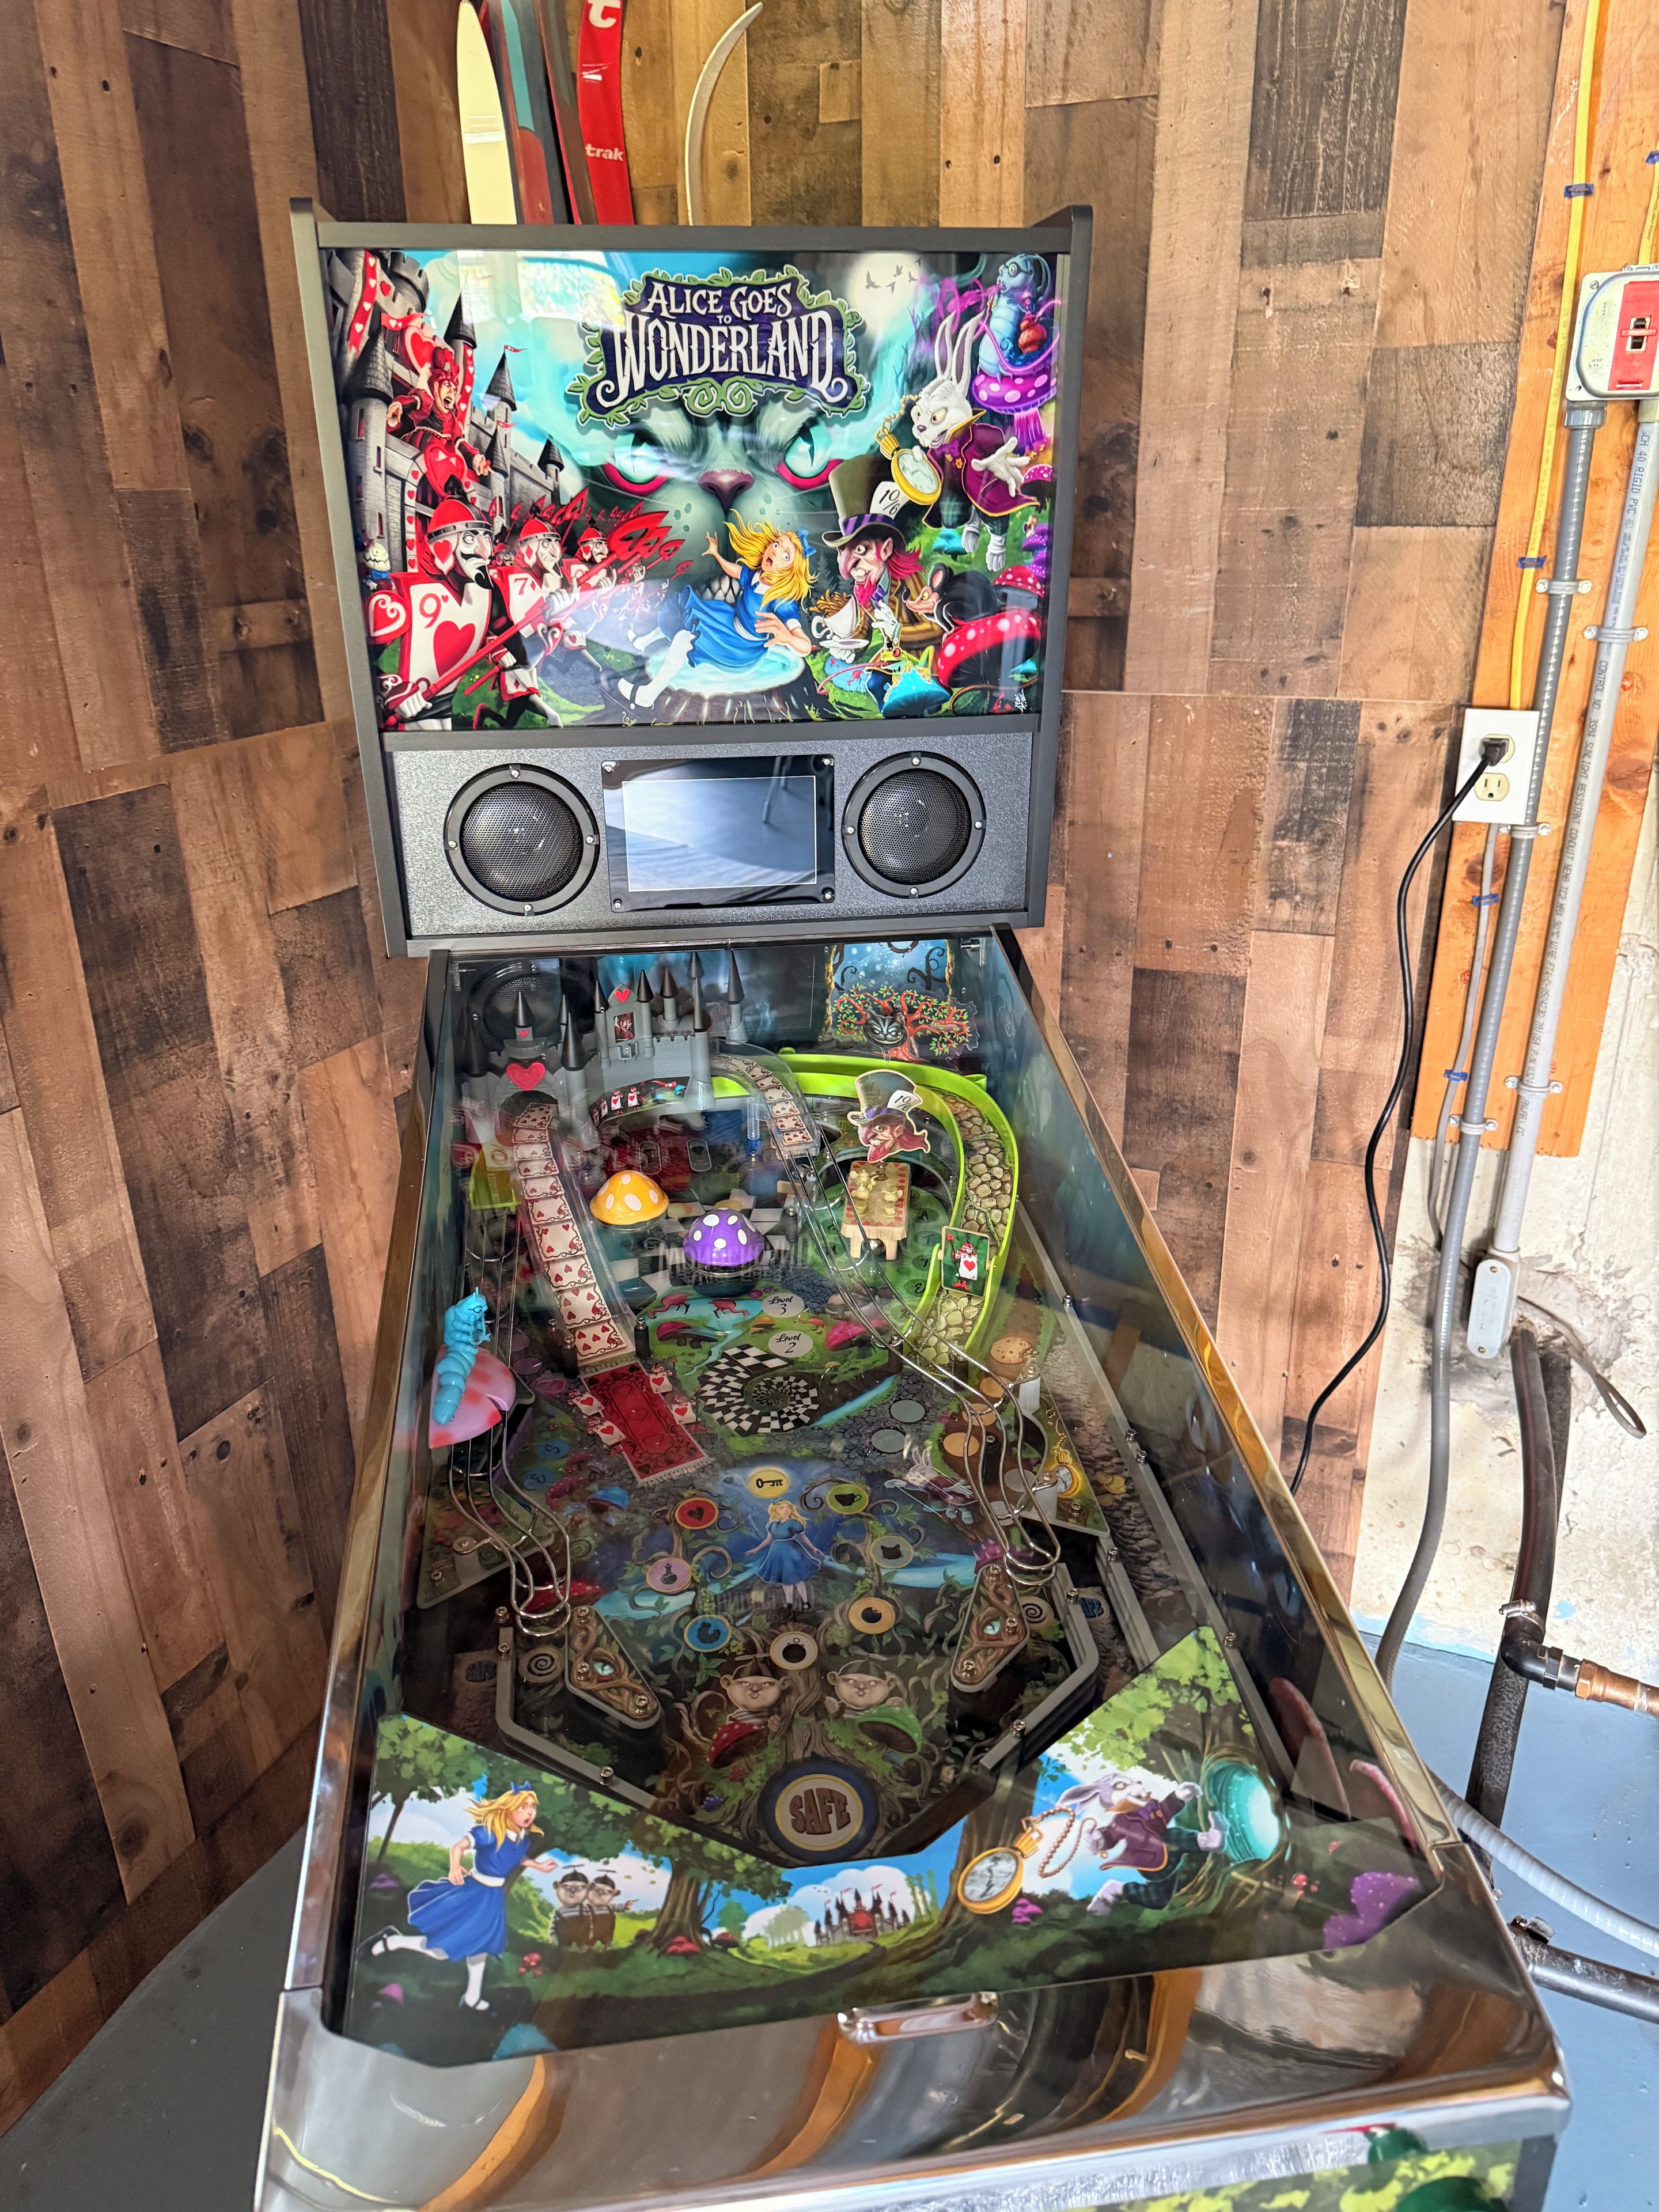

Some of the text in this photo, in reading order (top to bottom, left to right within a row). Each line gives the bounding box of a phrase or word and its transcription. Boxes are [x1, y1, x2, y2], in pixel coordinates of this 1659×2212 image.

[586, 143, 624, 161] trak
[640, 282, 792, 321] ALICE GOES
[717, 315, 732, 325] TO
[596, 309, 849, 408] WONDERLAND
[1637, 450, 1647, 463] 40
[1630, 465, 1645, 494] RIGID
[1626, 497, 1638, 515] PVC
[514, 577, 529, 596] 7
[419, 592, 442, 628] 9
[1593, 660, 1609, 694] CONTROL
[1579, 741, 1594, 778] SUNLIGHT
[1572, 782, 1588, 824] RESISTANT
[1565, 827, 1579, 860] CONDUIT
[1555, 902, 1565, 916] MAX
[1547, 940, 1559, 959] WIRE
[768, 1296, 800, 1305] Level
[779, 1303, 793, 1315] 3
[775, 1333, 802, 1343] Level
[785, 1342, 796, 1353] 2
[789, 1787, 851, 1835] SAFE
